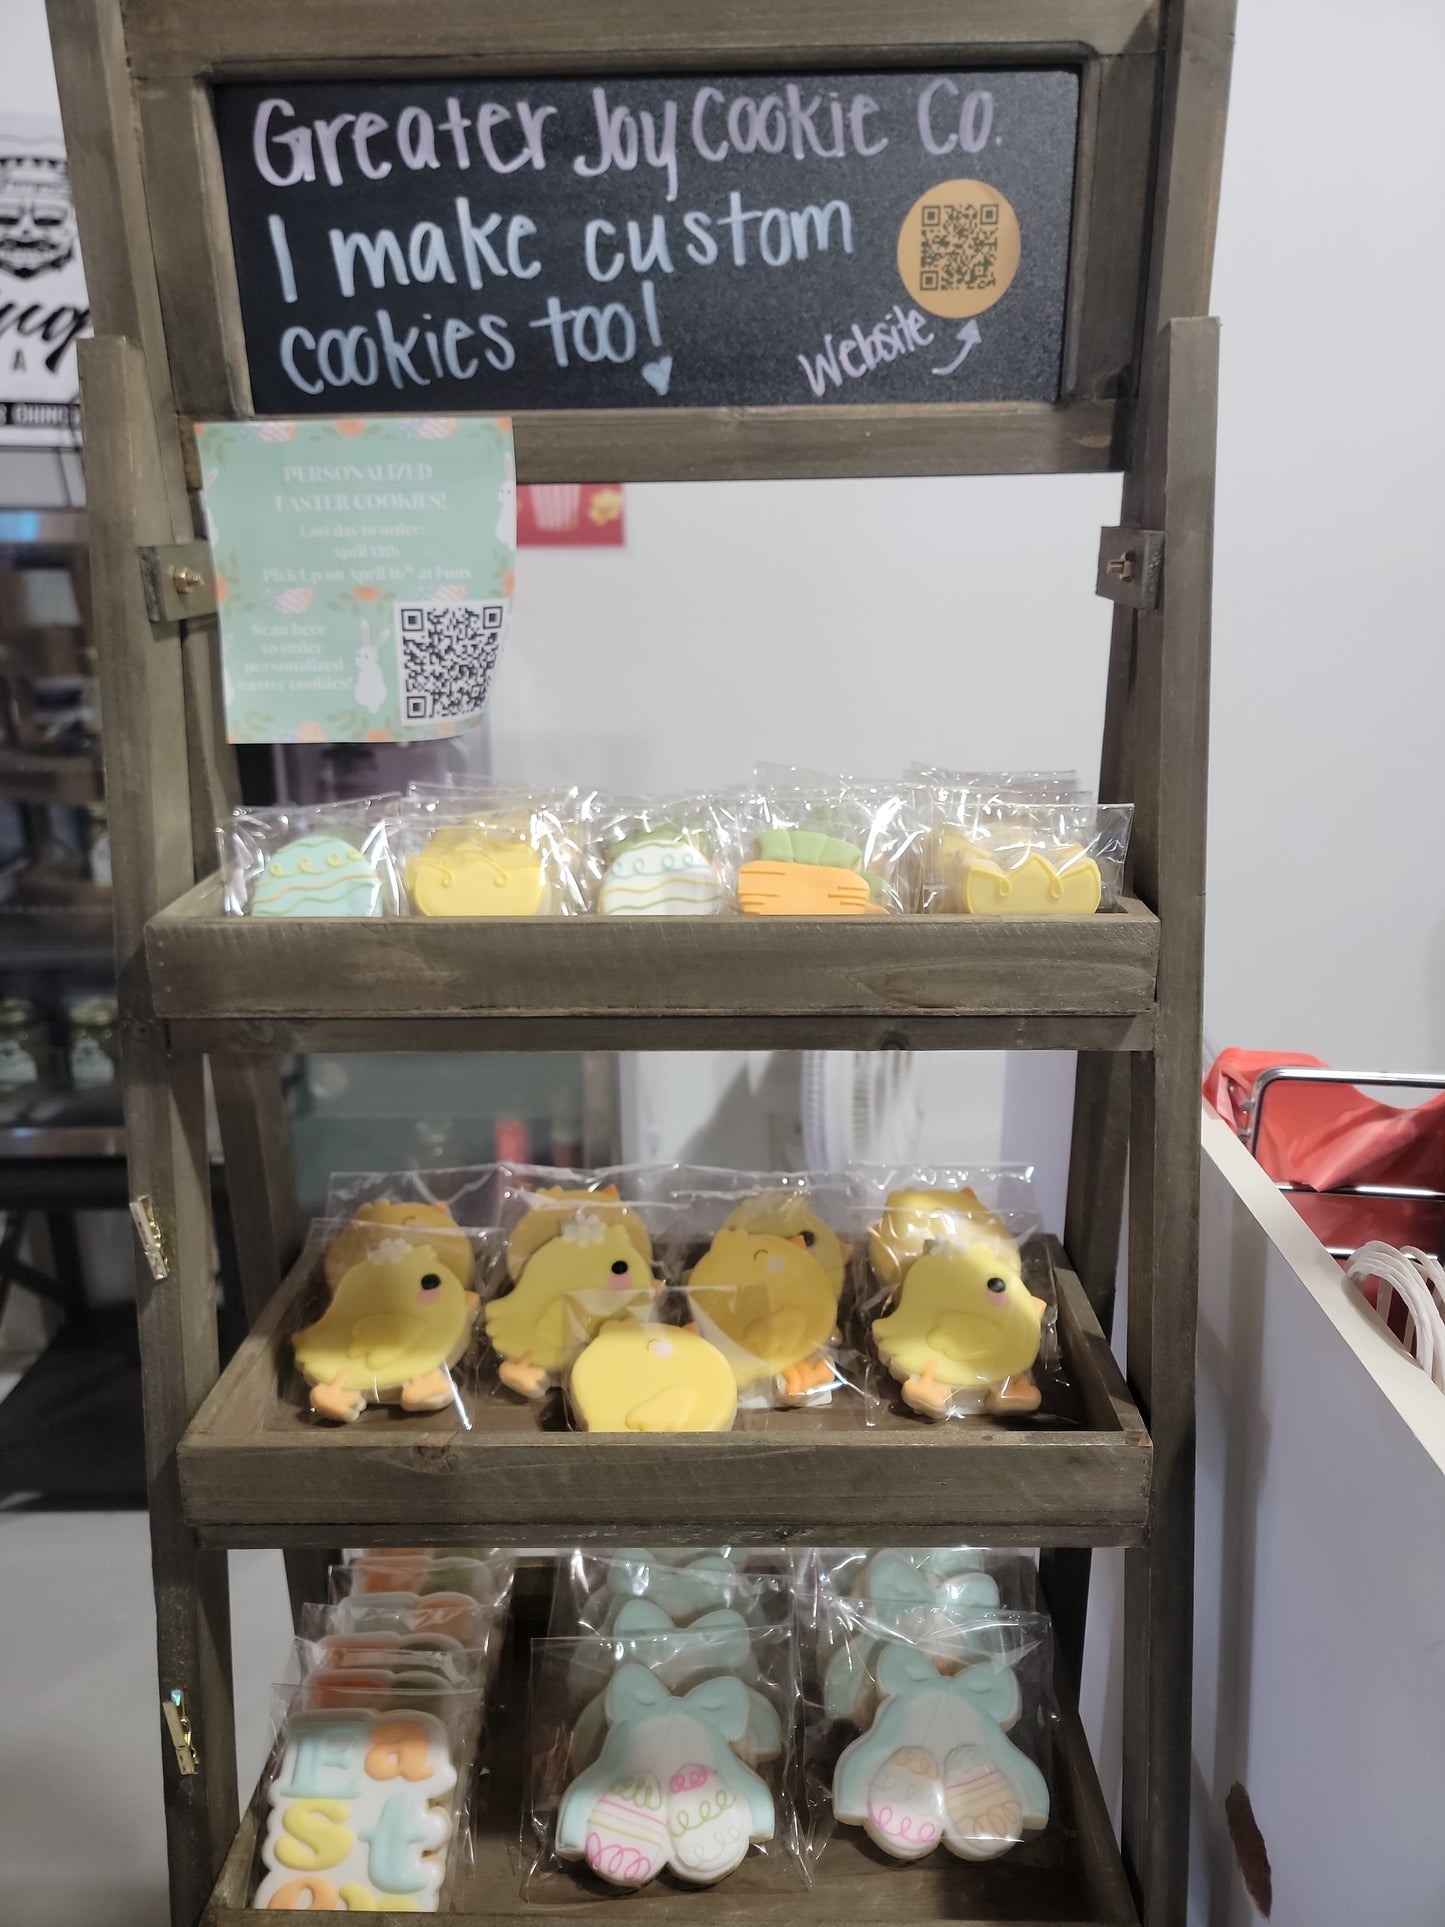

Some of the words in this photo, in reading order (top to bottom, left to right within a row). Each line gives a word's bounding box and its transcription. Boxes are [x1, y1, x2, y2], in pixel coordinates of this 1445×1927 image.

[253, 97, 557, 187] Greater
[573, 87, 678, 202] Joy
[692, 83, 889, 161] Cookie
[918, 78, 1002, 155] Co.
[268, 214, 298, 303] I
[328, 196, 542, 297] make
[584, 190, 854, 282] custom
[279, 308, 516, 394] cookies
[528, 279, 663, 367] too!
[799, 304, 934, 397] Website
[283, 464, 434, 484] PERSONALIZED
[274, 493, 350, 513] EASTER
[299, 524, 330, 539] Last
[333, 523, 358, 540] day
[361, 525, 377, 538] to
[333, 544, 369, 562] April
[325, 569, 345, 582] on
[349, 564, 386, 584] April
[250, 624, 289, 637] Scan
[291, 622, 327, 636] here
[260, 643, 278, 655] to
[244, 658, 344, 675] personalized
